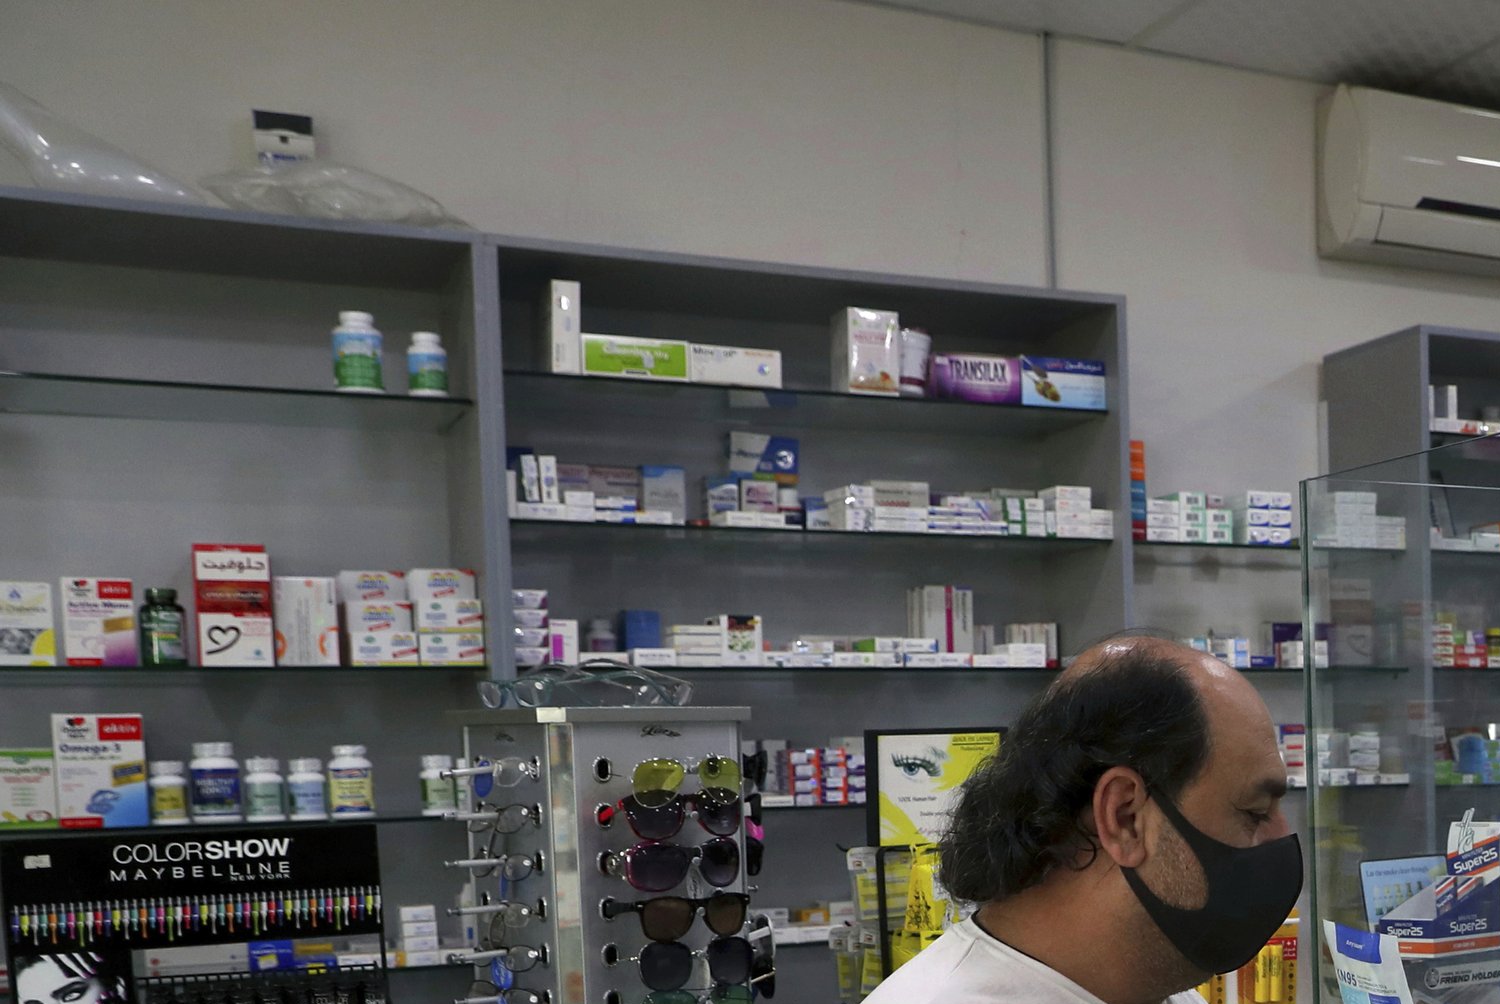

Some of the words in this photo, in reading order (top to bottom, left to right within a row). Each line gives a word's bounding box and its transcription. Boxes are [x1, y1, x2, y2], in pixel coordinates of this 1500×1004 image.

[1454, 846, 1498, 873] Super25
[110, 862, 290, 881] MAYBELLINE
[1387, 925, 1424, 936] Super25
[1439, 973, 1469, 984] FRIEND
